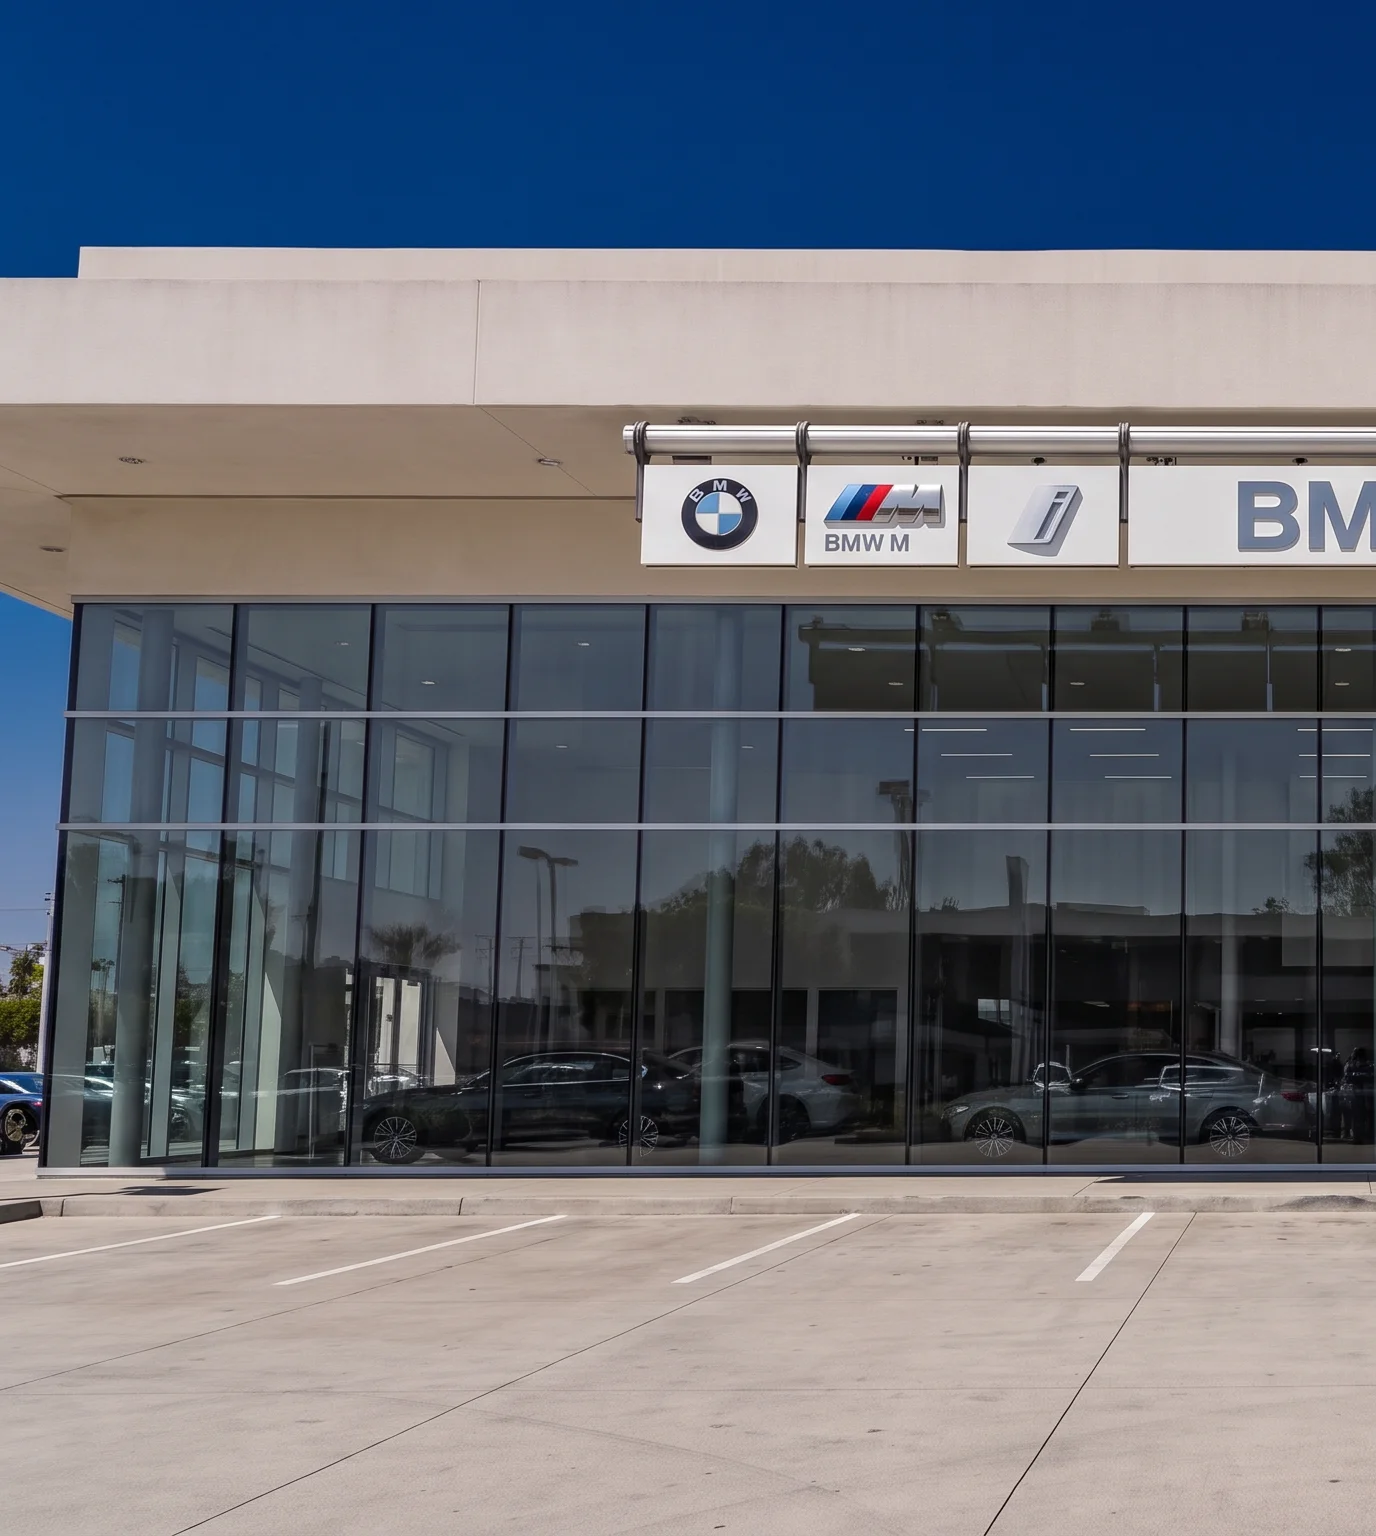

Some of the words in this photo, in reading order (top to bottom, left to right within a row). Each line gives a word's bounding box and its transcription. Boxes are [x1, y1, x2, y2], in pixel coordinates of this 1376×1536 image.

[689, 479, 753, 504] BMW
[874, 483, 946, 529] M
[1034, 490, 1069, 540] i
[824, 533, 884, 552] BMW
[890, 533, 910, 552] M
